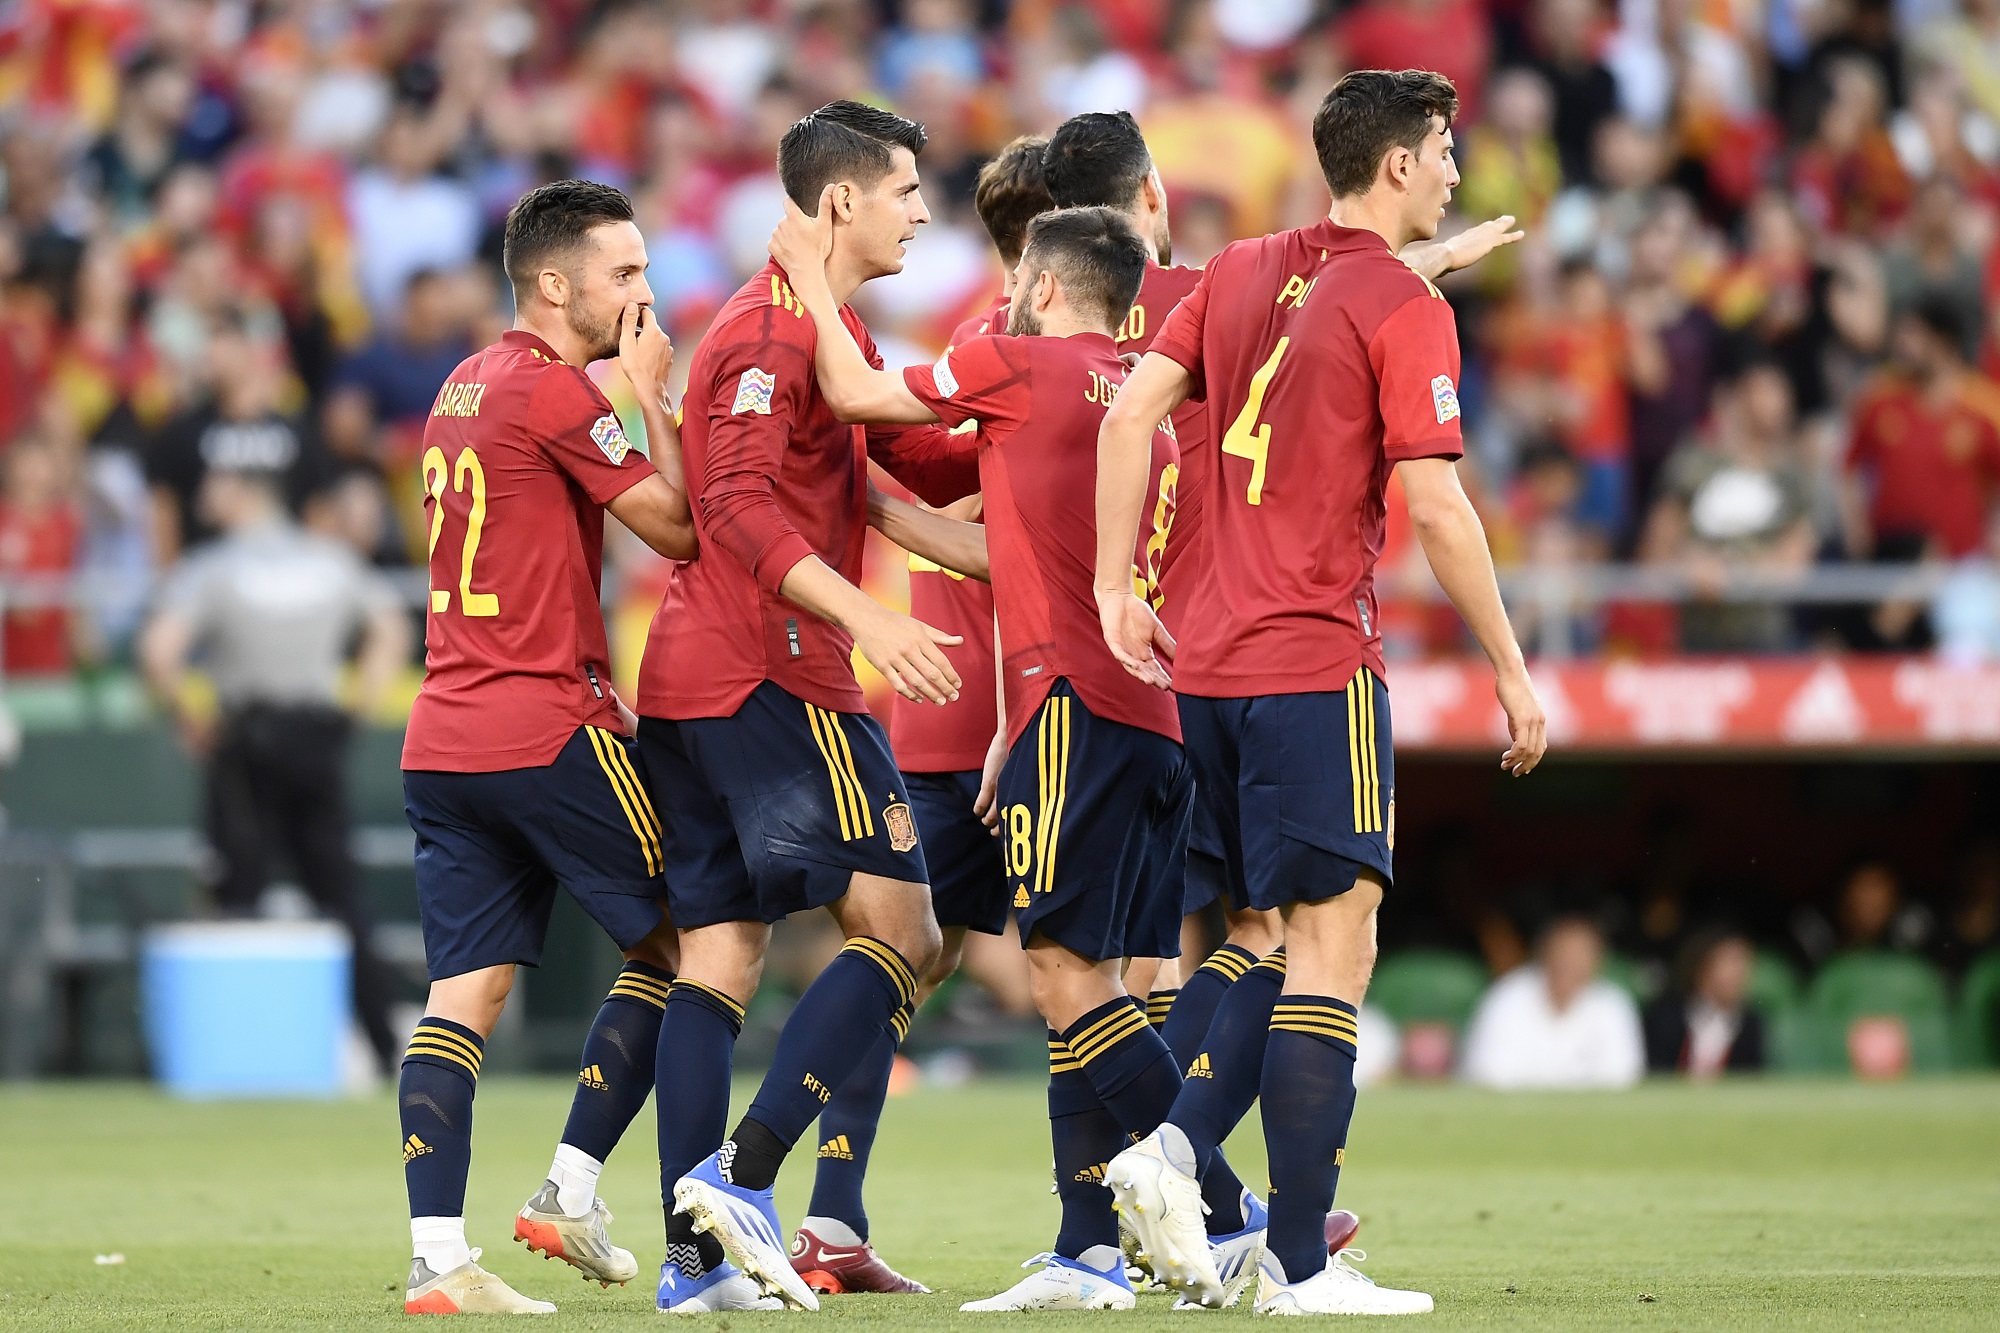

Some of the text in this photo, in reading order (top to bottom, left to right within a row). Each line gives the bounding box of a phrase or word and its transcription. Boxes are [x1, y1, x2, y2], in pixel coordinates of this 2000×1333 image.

[1222, 336, 1290, 506] 4
[423, 446, 500, 617] 22
[817, 1150, 854, 1161] adidas
